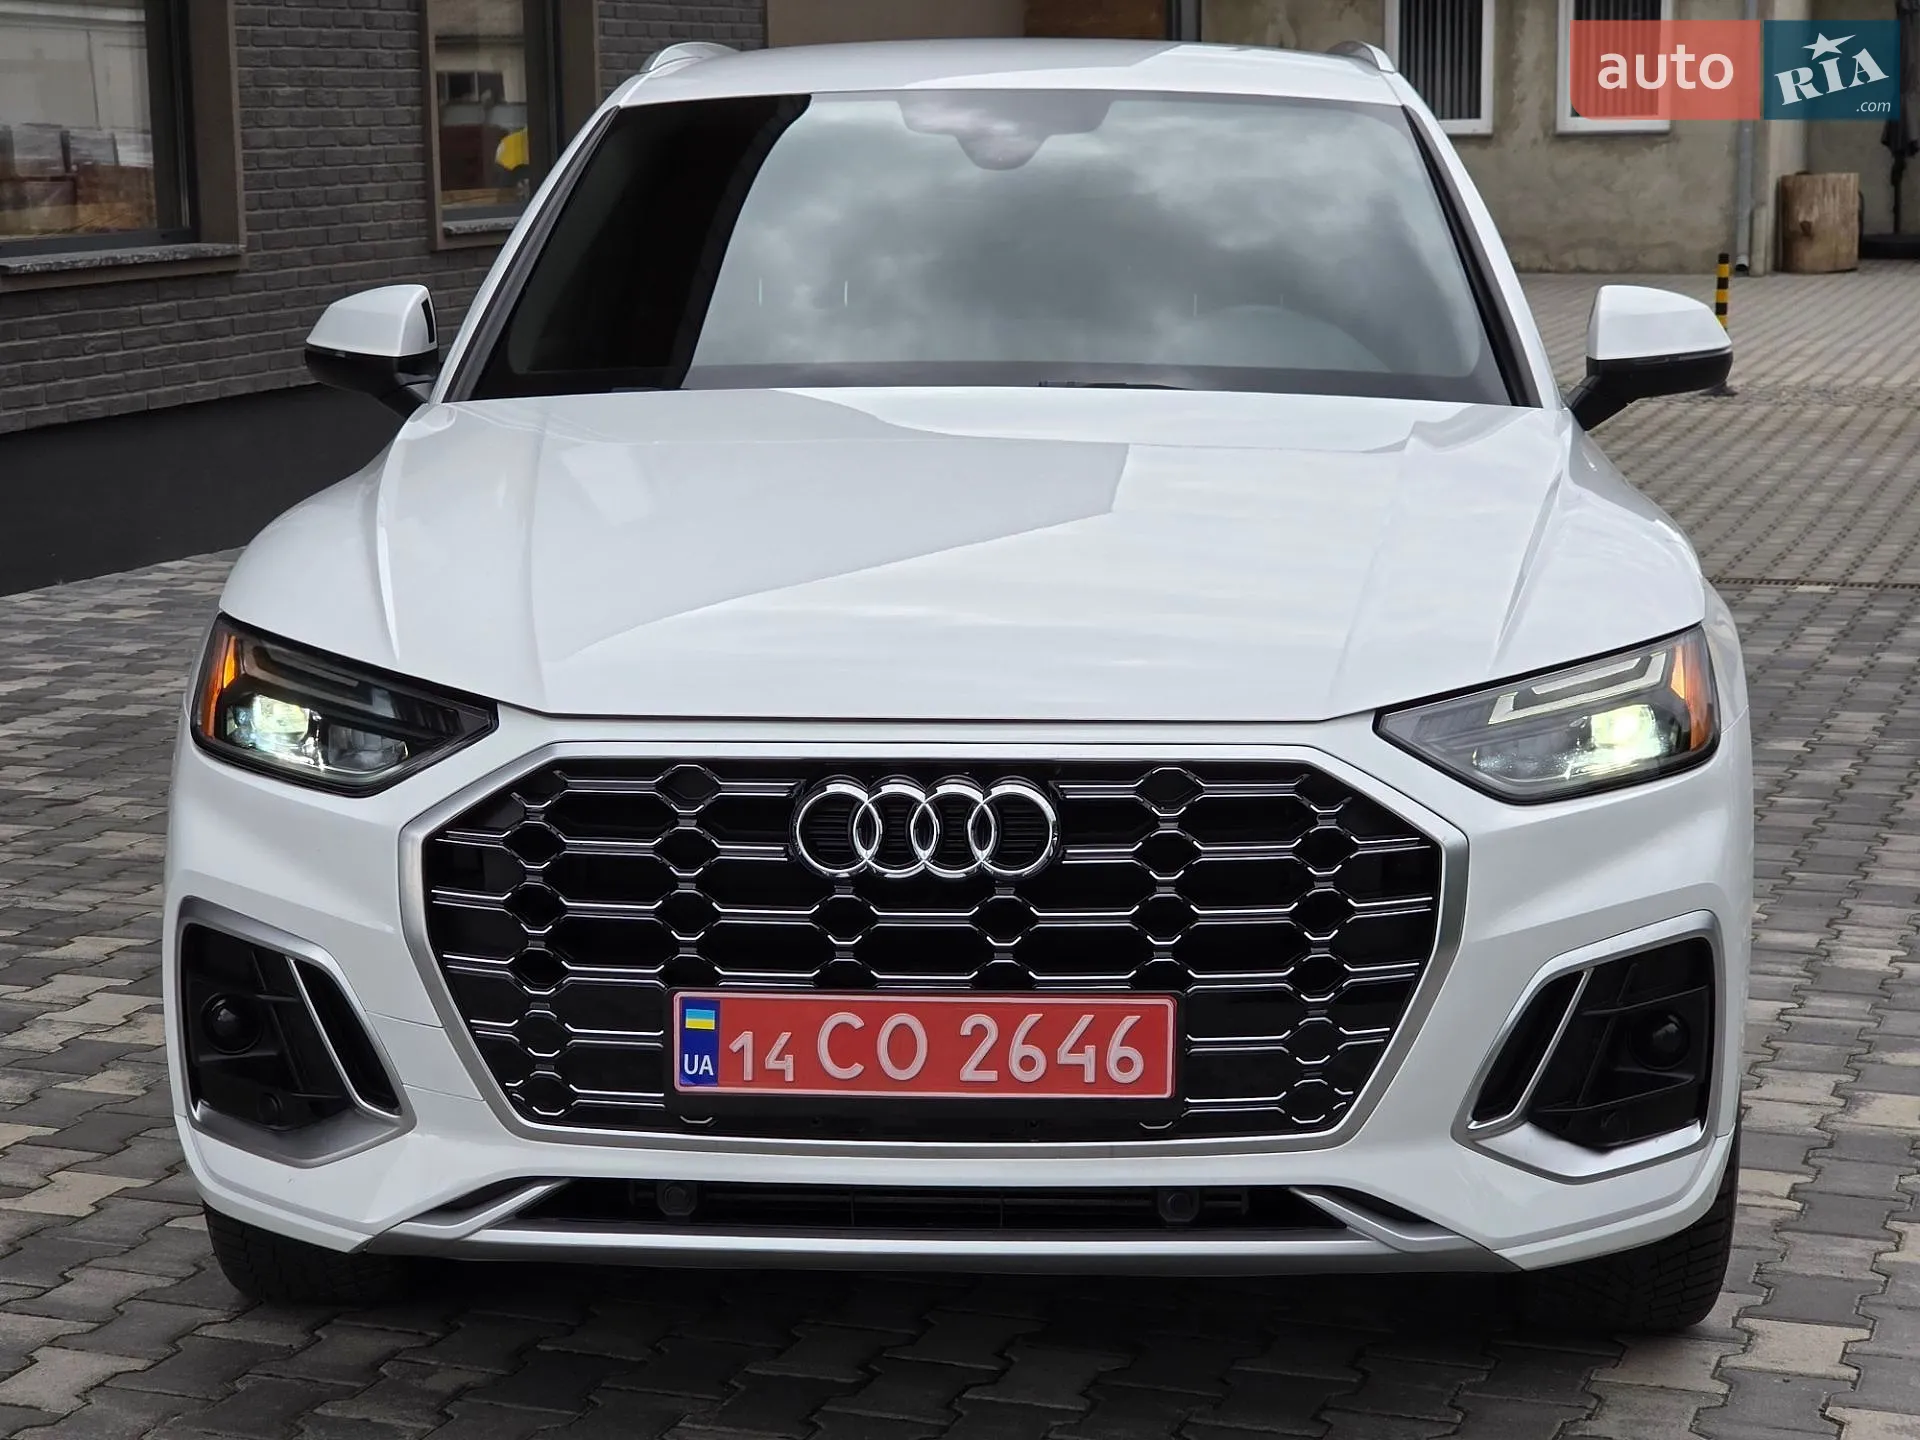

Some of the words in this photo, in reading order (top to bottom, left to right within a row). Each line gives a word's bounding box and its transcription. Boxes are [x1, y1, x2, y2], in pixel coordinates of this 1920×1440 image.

[683, 1053, 714, 1077] UA
[728, 1030, 795, 1083] 14
[816, 1011, 929, 1081] CO
[958, 1012, 1145, 1084] 2646
